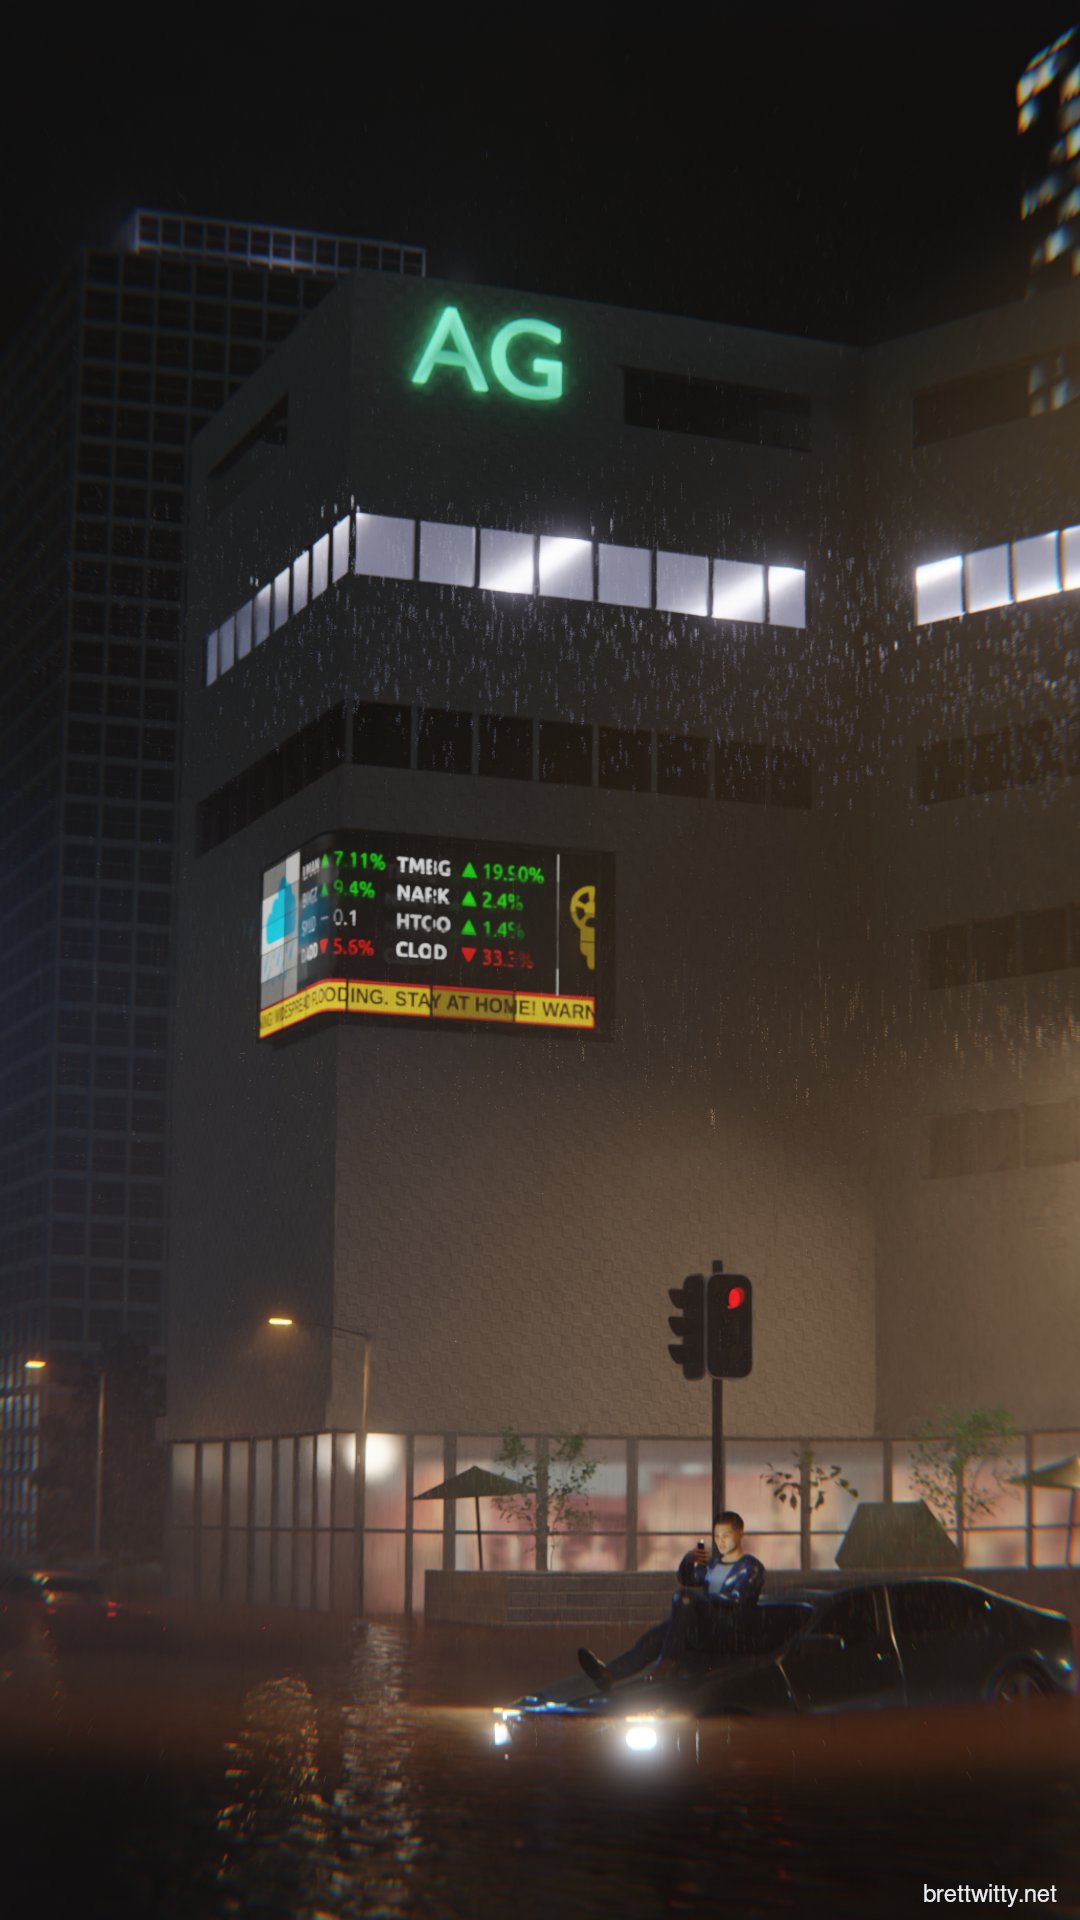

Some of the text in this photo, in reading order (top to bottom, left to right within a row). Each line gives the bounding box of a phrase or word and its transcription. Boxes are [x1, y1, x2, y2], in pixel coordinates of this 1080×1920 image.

[412, 305, 563, 401] AG
[333, 851, 386, 871] 7.11%
[333, 879, 375, 899] 9.4%
[481, 891, 524, 911] 2.4%
[482, 920, 526, 940] 1.4%
[333, 937, 375, 956] 5.6%
[395, 941, 448, 960] CLOD
[395, 991, 441, 1008] STAY
[446, 995, 470, 1012] AT
[475, 996, 536, 1016] HOME!
